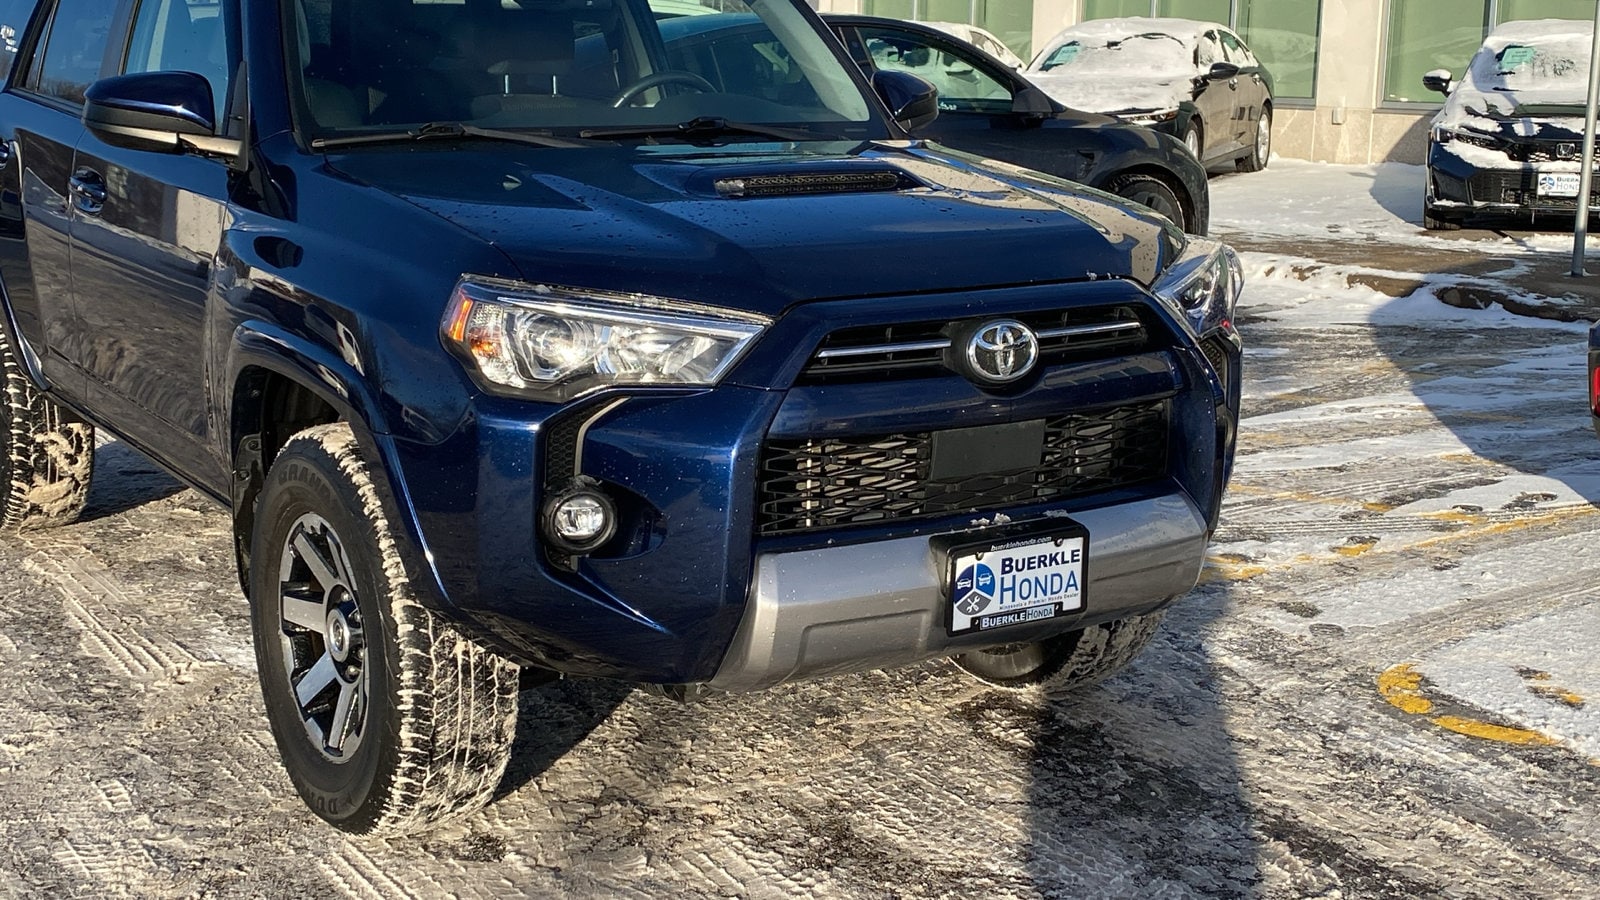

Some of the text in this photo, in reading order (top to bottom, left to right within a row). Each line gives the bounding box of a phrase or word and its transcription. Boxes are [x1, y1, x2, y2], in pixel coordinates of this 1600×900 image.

[990, 536, 1052, 551] buerklehonda.com
[1001, 549, 1080, 575] BUERKLE
[1000, 570, 1079, 604] HONDA
[982, 606, 1053, 628] BUERKLE HONDA
